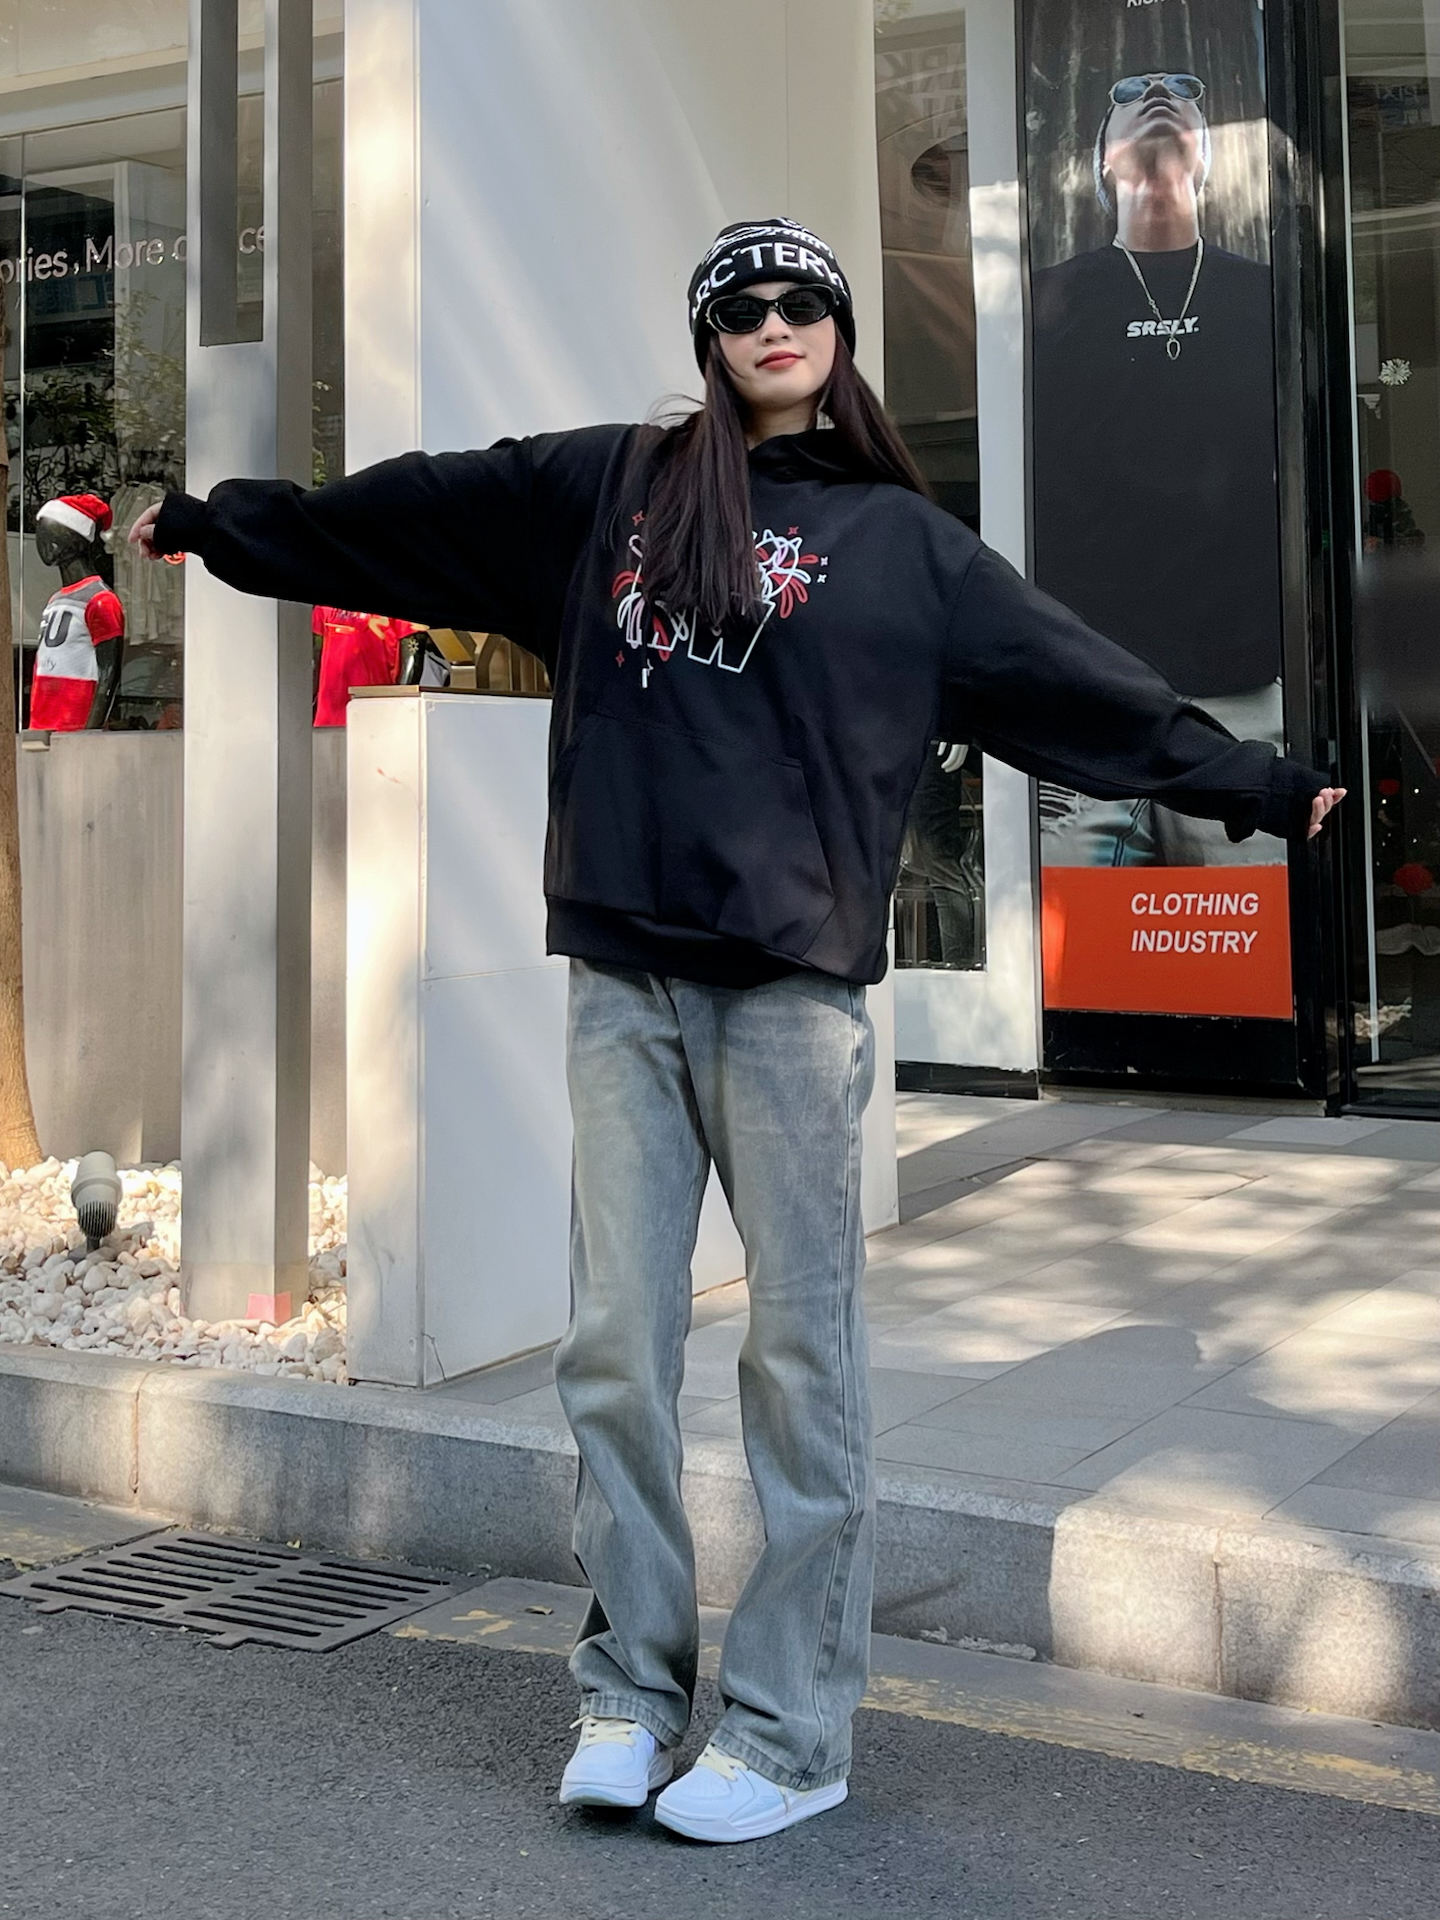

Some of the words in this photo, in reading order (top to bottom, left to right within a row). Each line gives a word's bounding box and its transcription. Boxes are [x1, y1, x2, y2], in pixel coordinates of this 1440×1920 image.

[85, 235, 165, 273] More
[1130, 892, 1260, 916] CLOTHING
[1131, 929, 1259, 954] INDUSTRY
